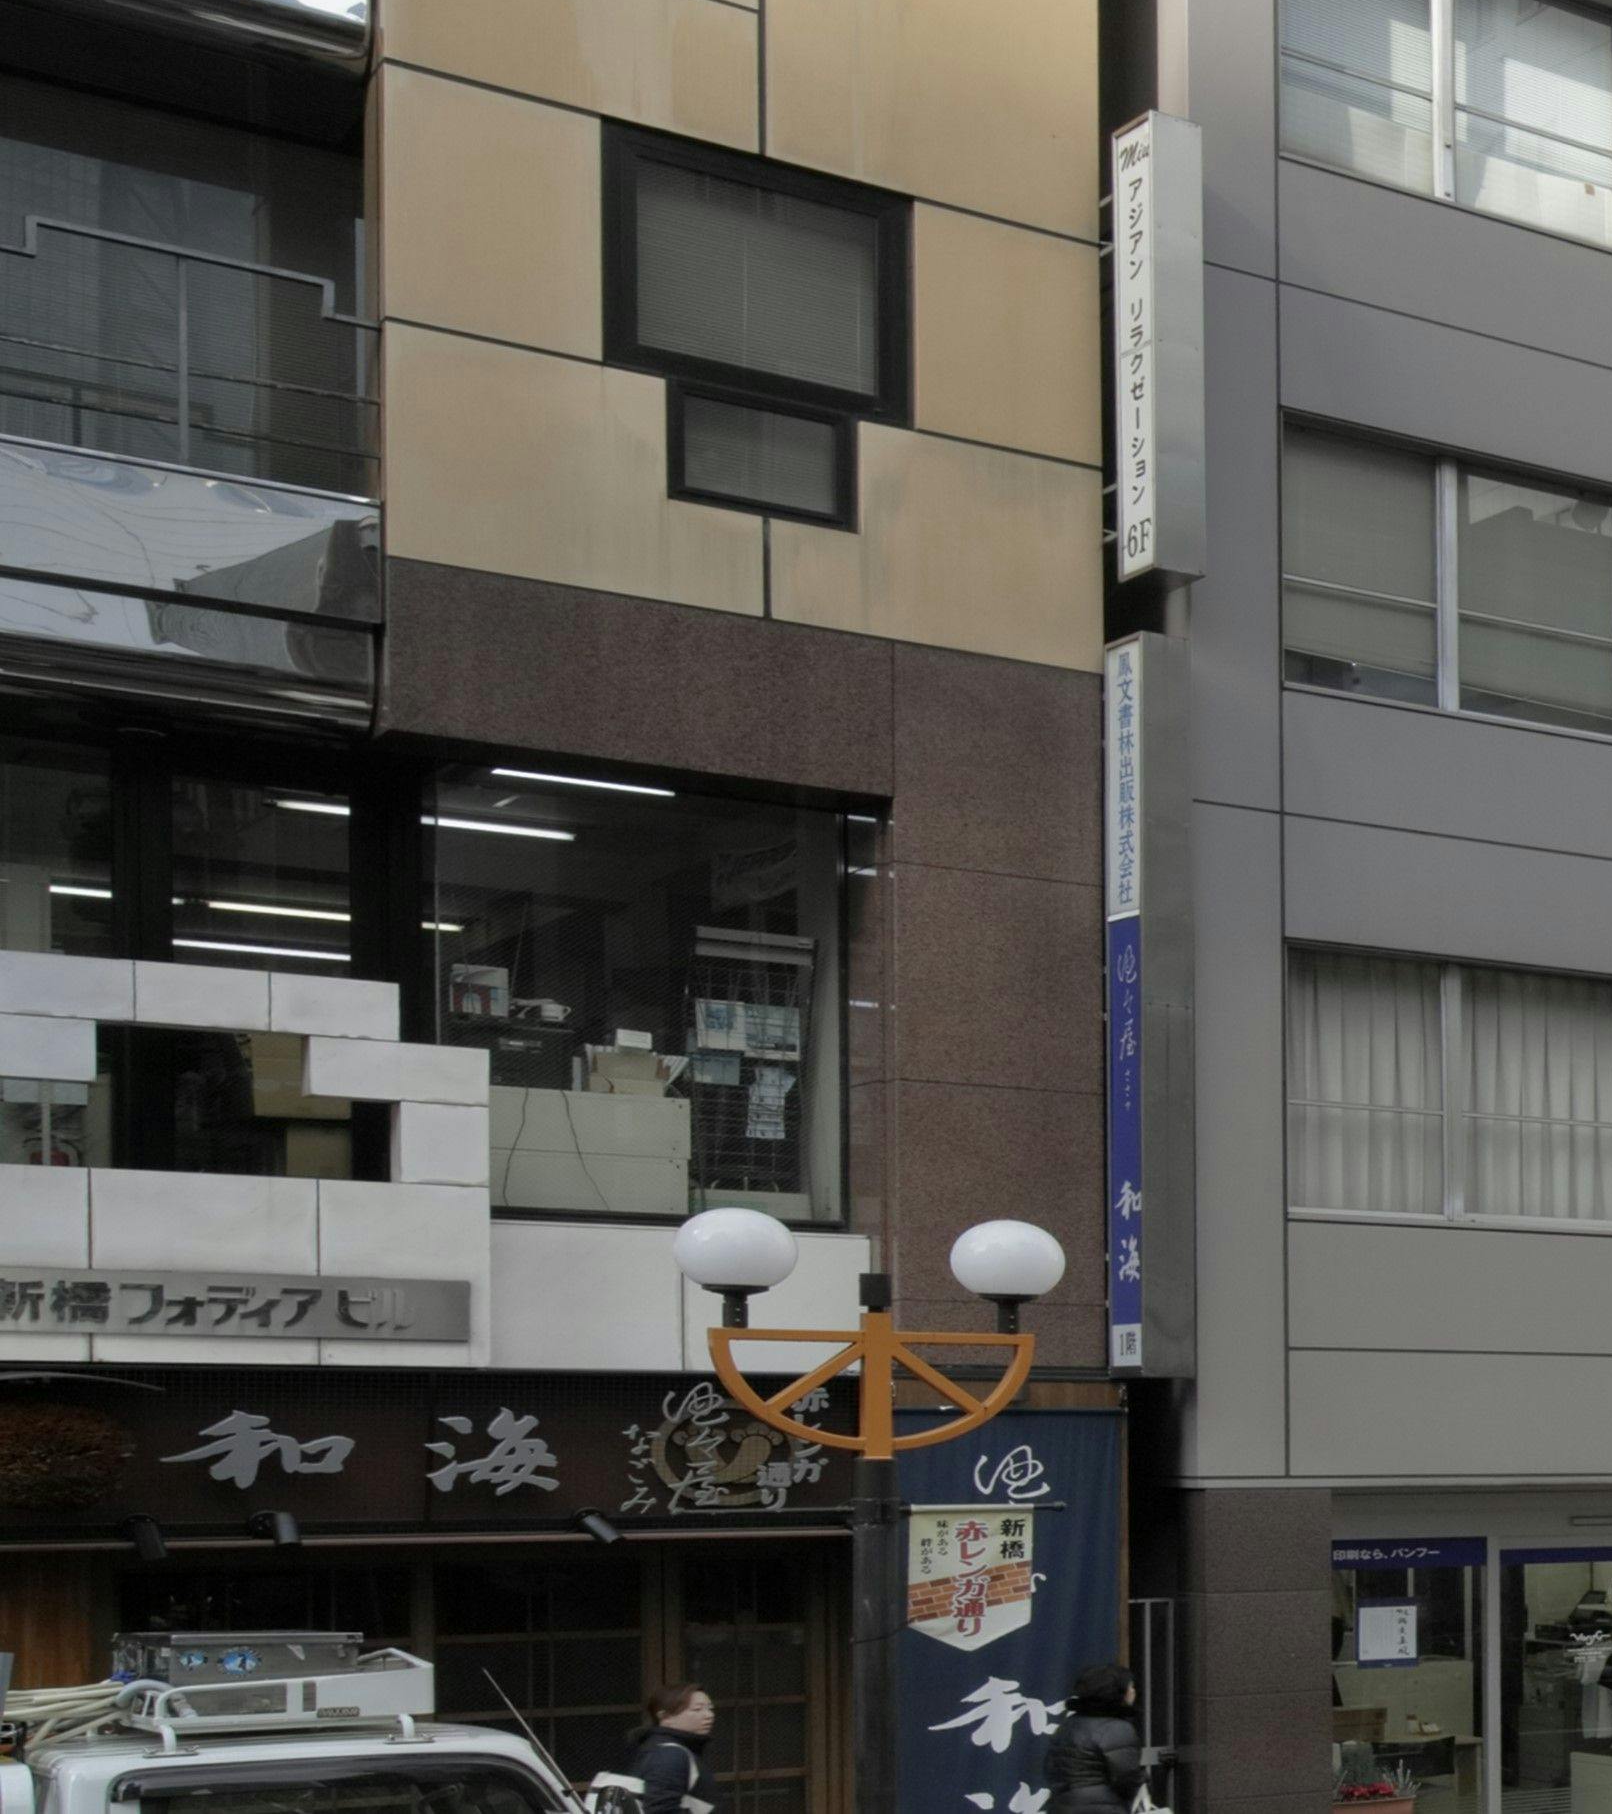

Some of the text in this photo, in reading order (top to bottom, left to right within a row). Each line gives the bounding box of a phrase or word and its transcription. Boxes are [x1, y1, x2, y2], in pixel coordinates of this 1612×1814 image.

[1128, 177, 1147, 506] アジアン リラクゼーション
[1127, 518, 1153, 560] 6F
[160, 1406, 561, 1494] 和海
[936, 1519, 949, 1557] 味がある
[1000, 1517, 1026, 1560] 新橋
[951, 1520, 991, 1638] 赤レンガ通り
